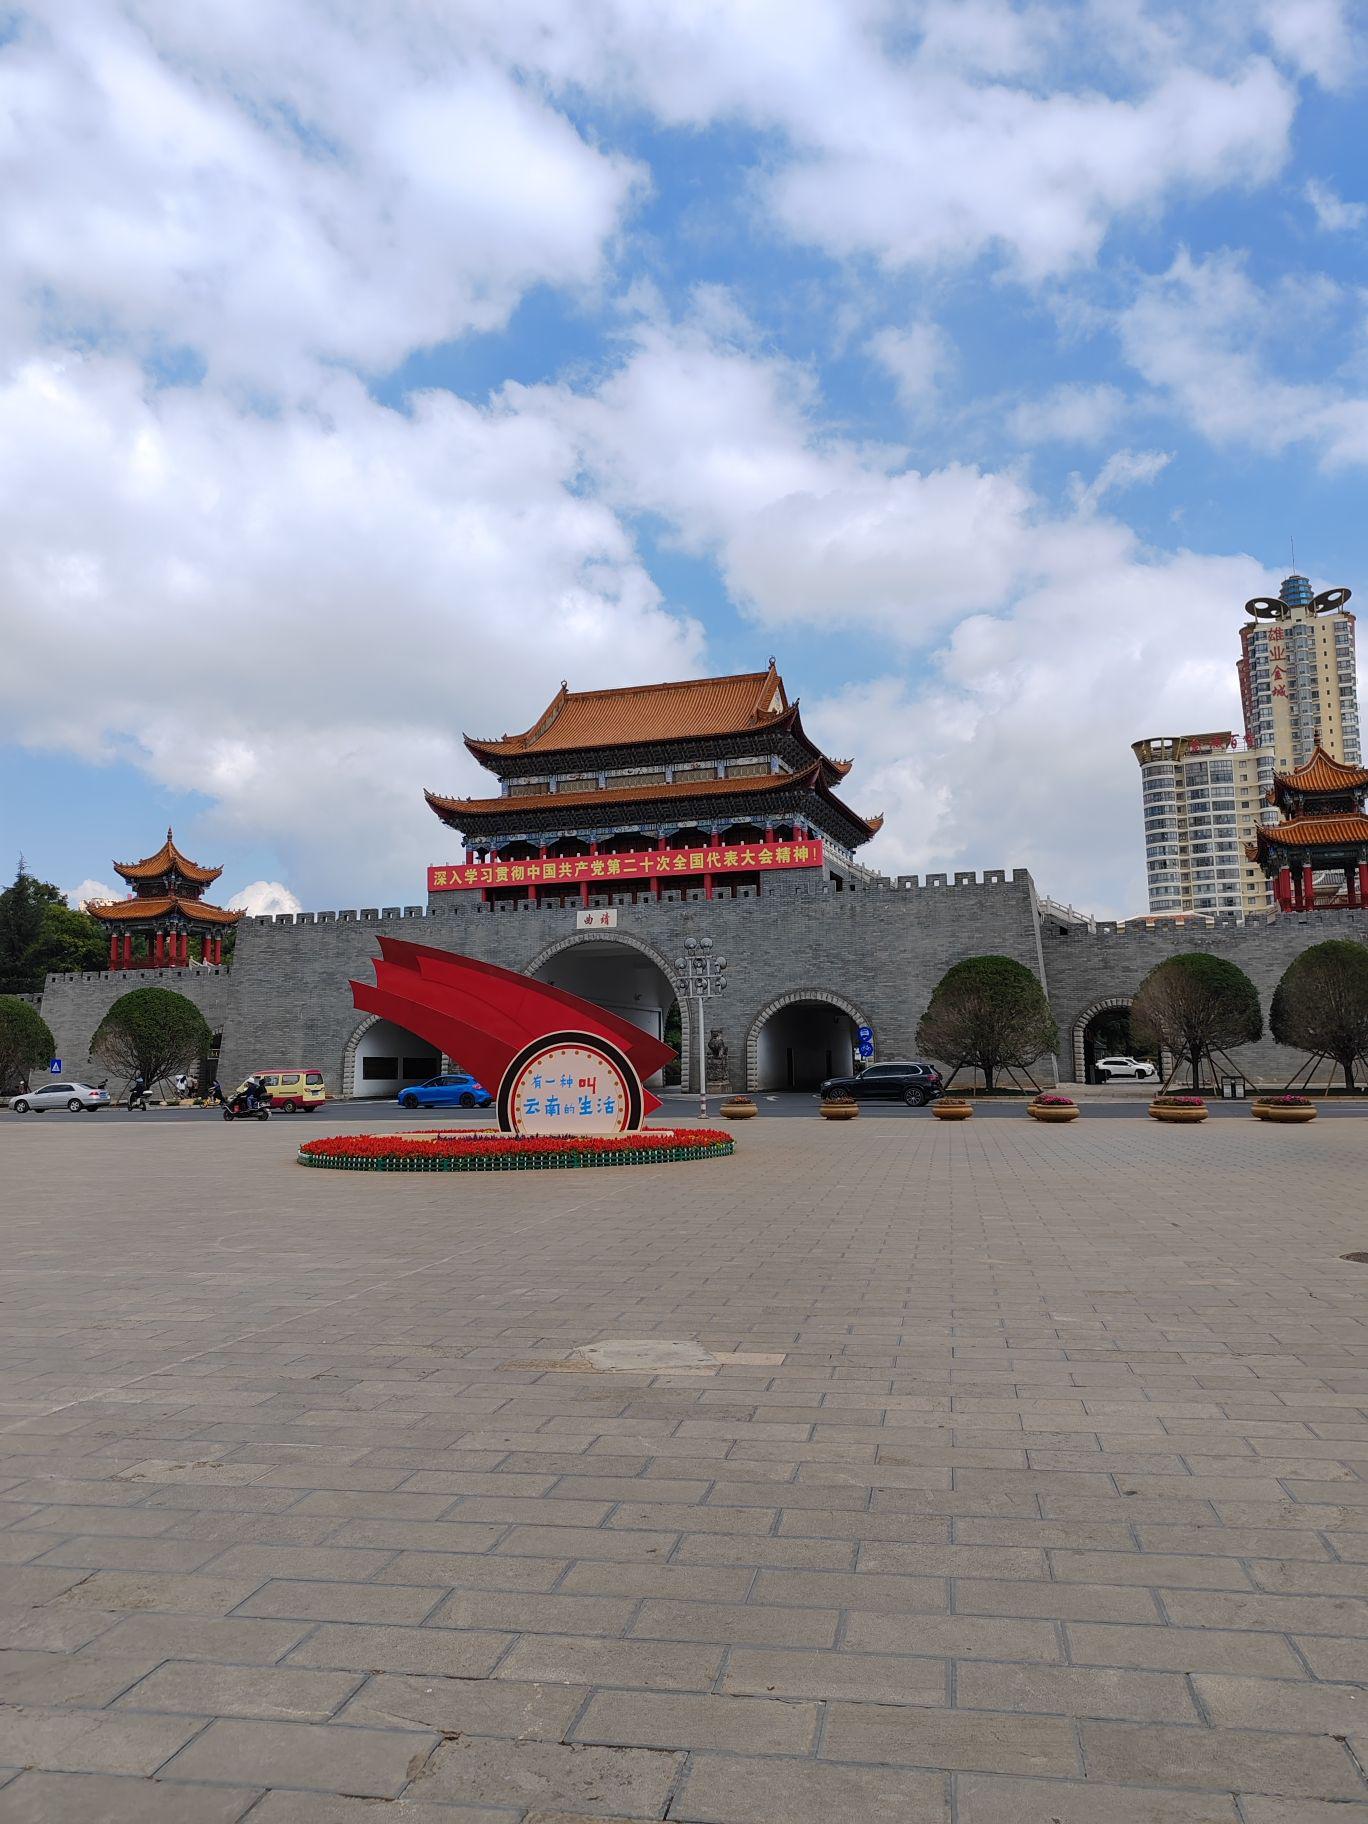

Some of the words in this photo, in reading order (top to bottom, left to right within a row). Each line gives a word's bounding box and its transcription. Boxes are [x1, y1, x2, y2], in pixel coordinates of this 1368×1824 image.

[1268, 626, 1288, 698] 雄业金城
[523, 1095, 615, 1116] 云南的生活
